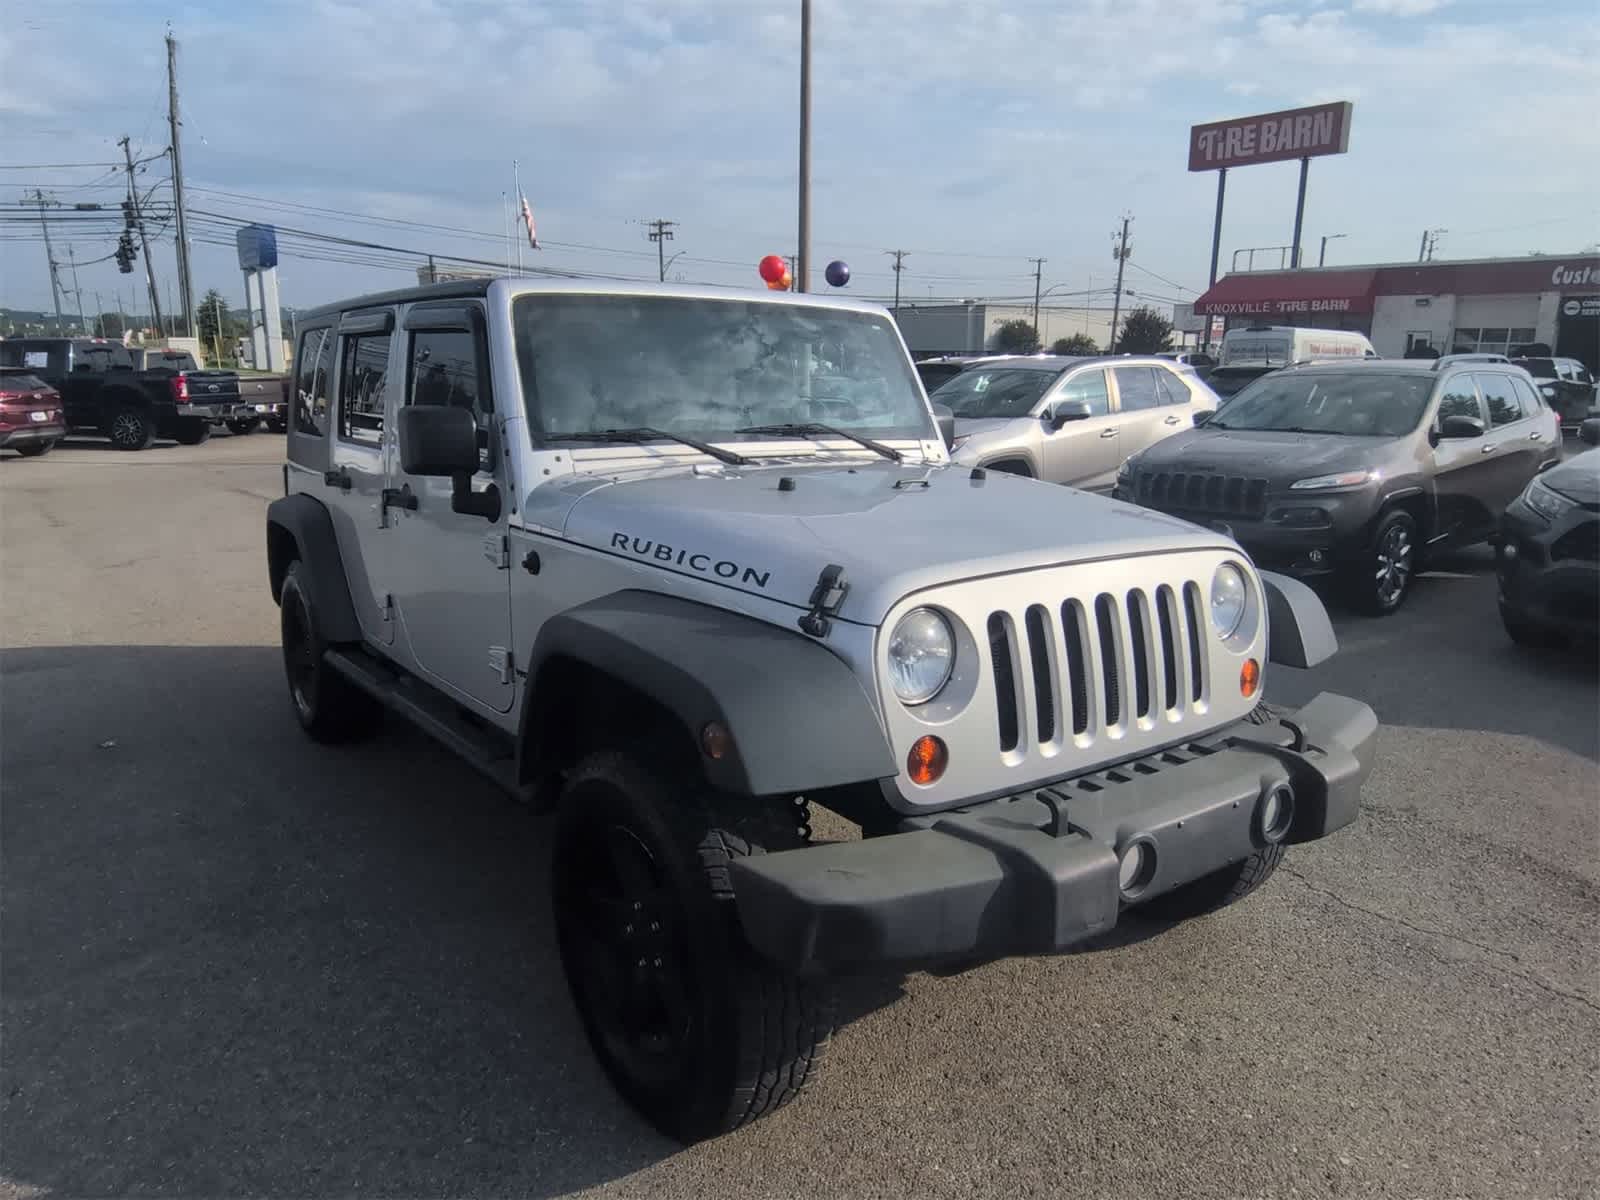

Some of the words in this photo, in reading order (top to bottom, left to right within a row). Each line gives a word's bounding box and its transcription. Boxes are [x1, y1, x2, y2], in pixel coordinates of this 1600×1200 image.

[1259, 111, 1334, 154] BARN
[1205, 302, 1271, 314] KNOXVILLE
[1311, 299, 1350, 312] BARN
[611, 532, 771, 588] RUBICON
